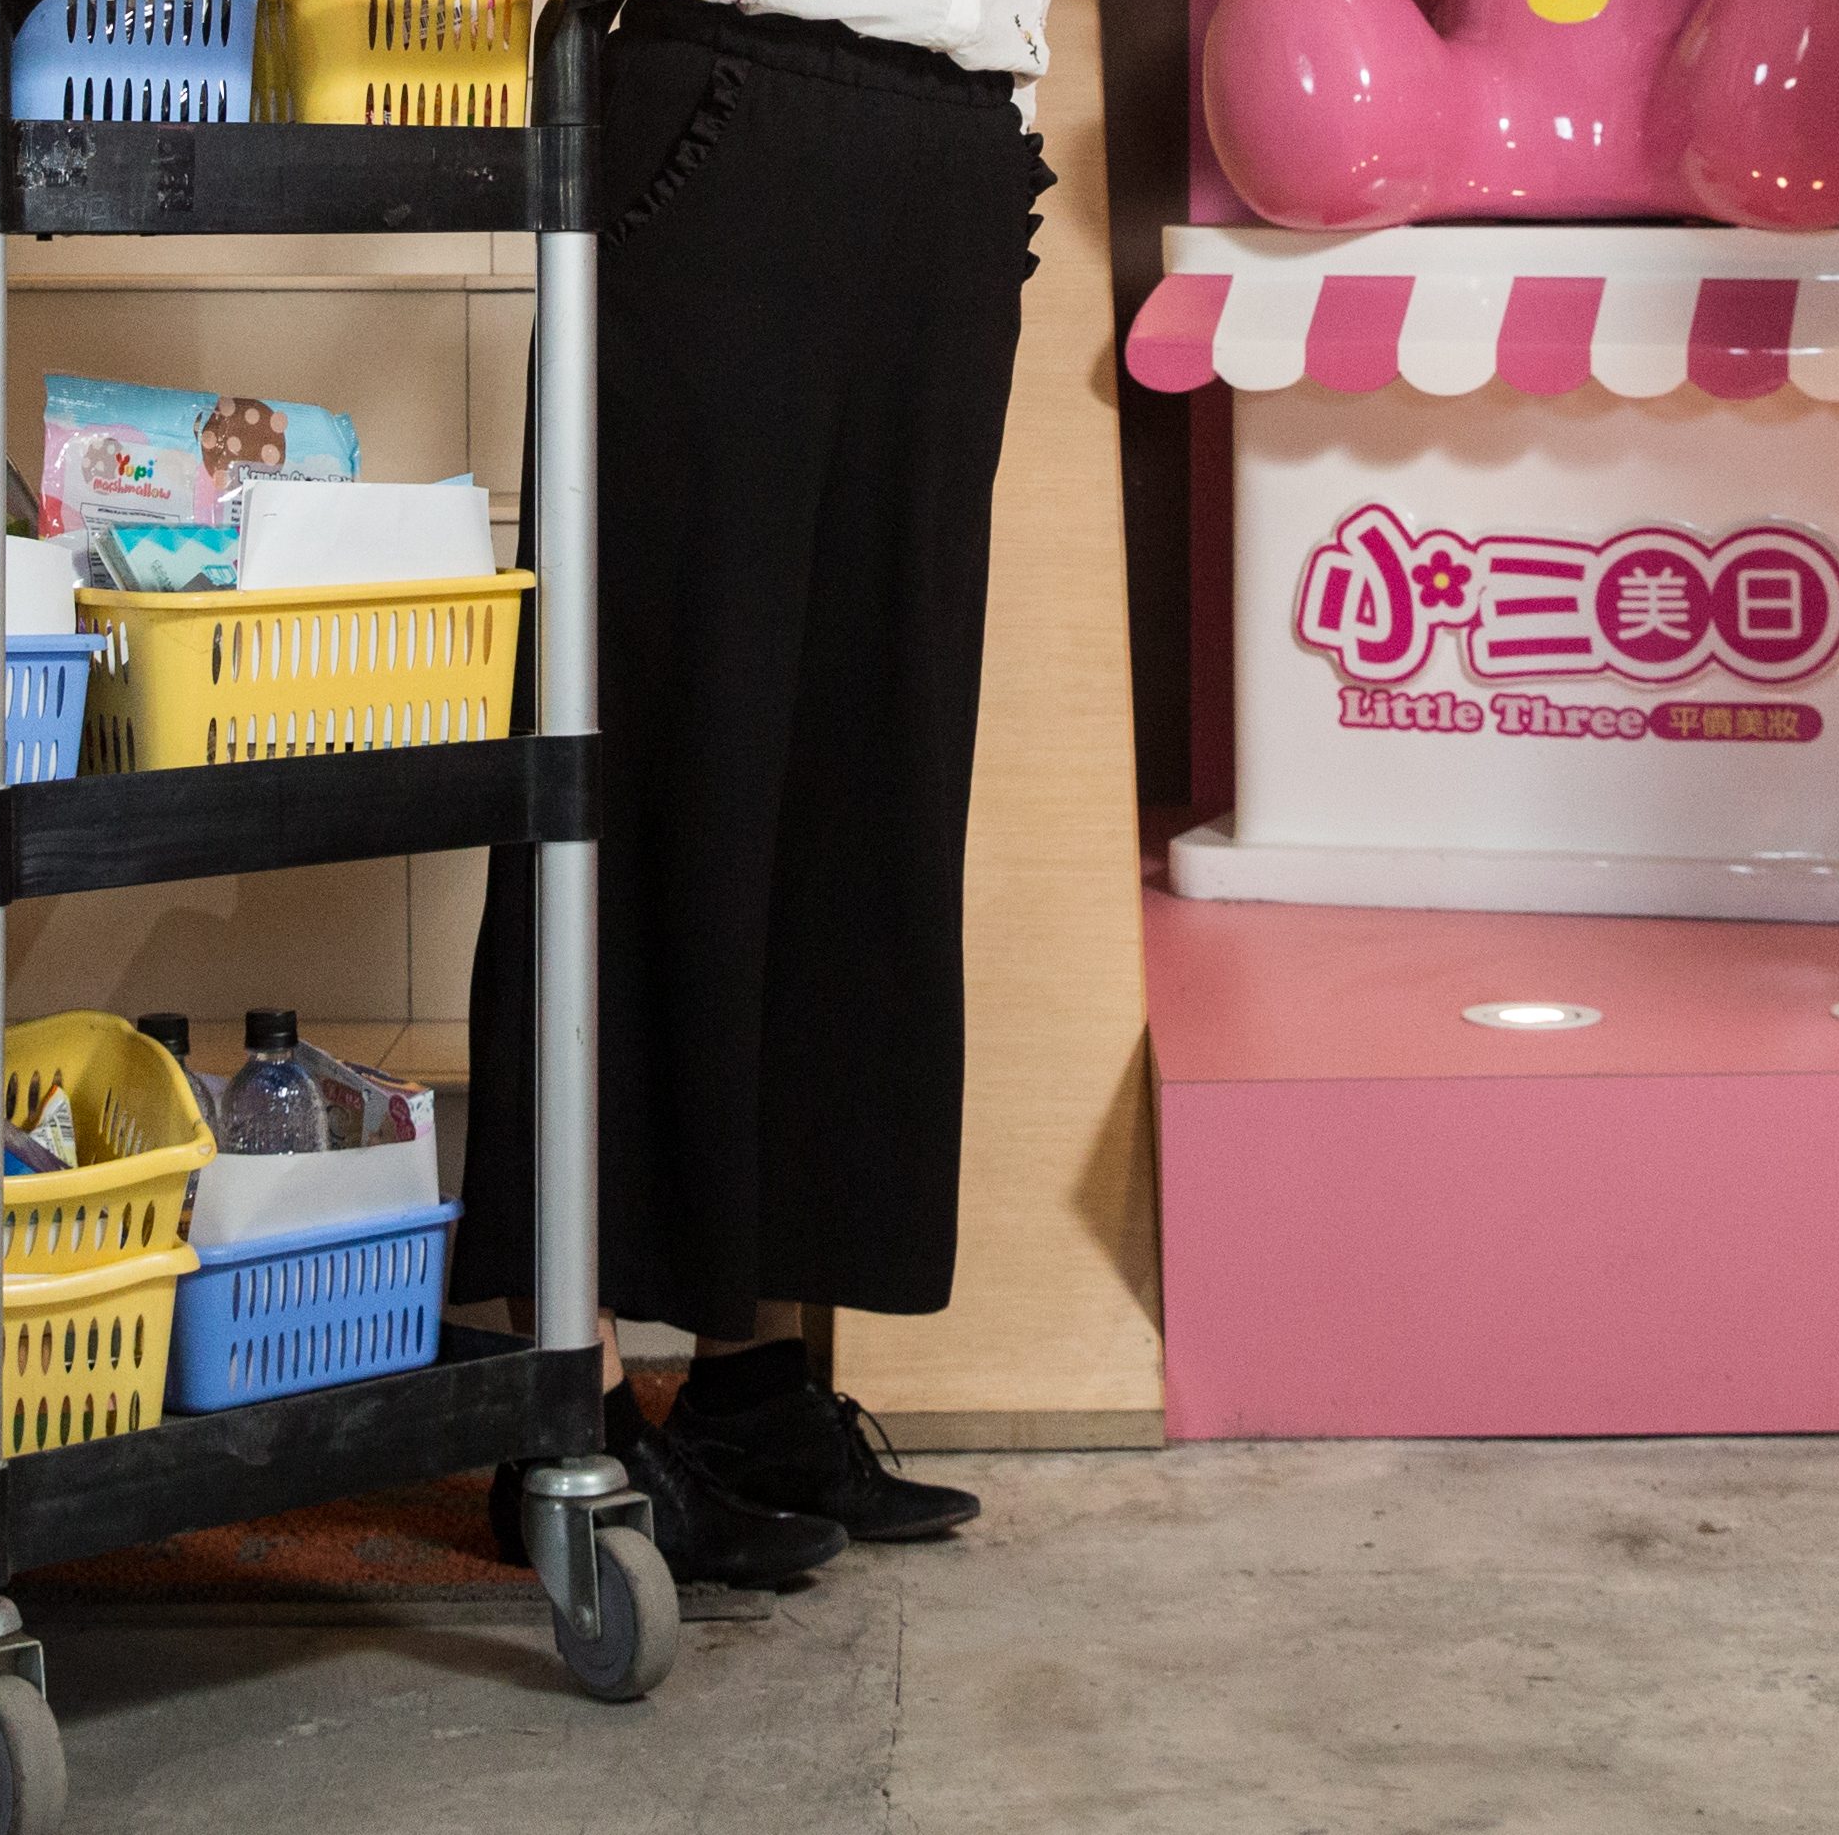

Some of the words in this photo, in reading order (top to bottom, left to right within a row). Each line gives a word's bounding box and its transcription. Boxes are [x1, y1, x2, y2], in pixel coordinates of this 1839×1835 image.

[115, 452, 155, 481] Yupi
[93, 478, 172, 500] marshmallow
[1317, 521, 1832, 669] 小三美日
[1338, 686, 1484, 734] Little
[1490, 691, 1648, 740] Three
[1667, 705, 1800, 738] 平價美妝
